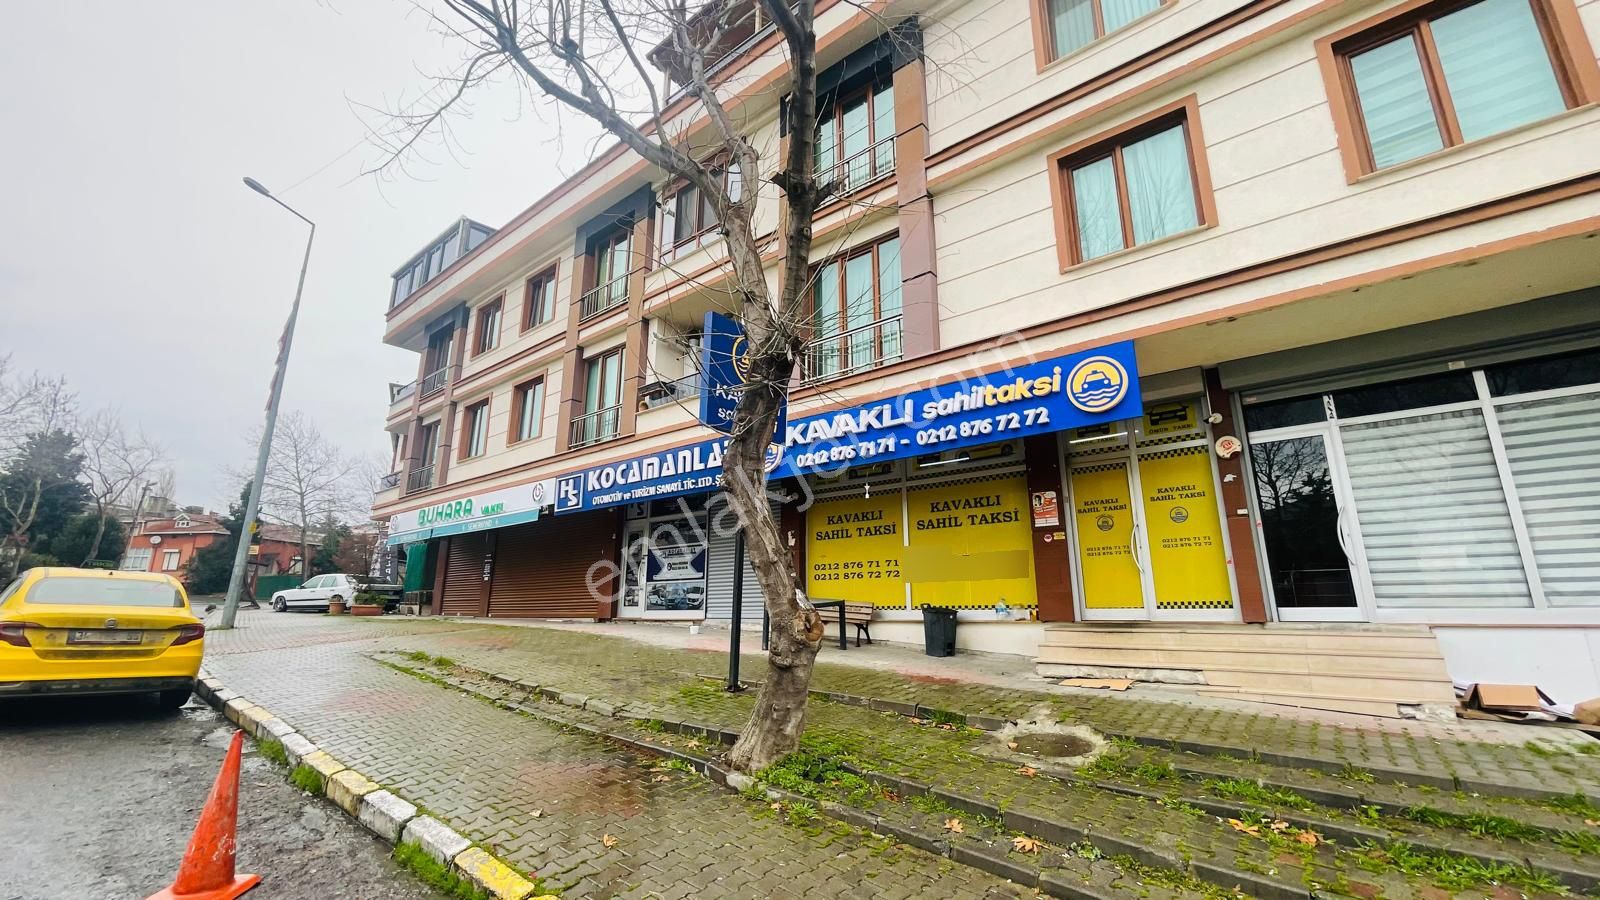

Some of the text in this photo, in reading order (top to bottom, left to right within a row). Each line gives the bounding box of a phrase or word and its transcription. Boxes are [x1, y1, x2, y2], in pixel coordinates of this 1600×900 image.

[787, 399, 913, 447] KAVAKLI
[797, 450, 830, 468] 0212
[830, 445, 857, 461] 876
[916, 425, 957, 446] 0212
[960, 418, 992, 437] 876
[996, 412, 1020, 431] 72
[1024, 407, 1050, 426] 72
[631, 486, 656, 499] TURİZM
[1157, 485, 1196, 493] KAVAKLI
[1178, 491, 1206, 499] TAKSİ
[930, 495, 1001, 513] KAVAKLI
[1083, 498, 1119, 506] KAVAKLI
[418, 498, 474, 526] BUHARA
[827, 510, 884, 525] KAVAKLI
[916, 514, 962, 530] SAHİL
[968, 508, 1020, 526] TAKSİ
[816, 522, 896, 541] SAHİL TAKSİ
[814, 563, 840, 571] 0212
[867, 560, 880, 568] 71
[885, 559, 899, 567] 71
[814, 570, 900, 581] 0212 876 72 72
